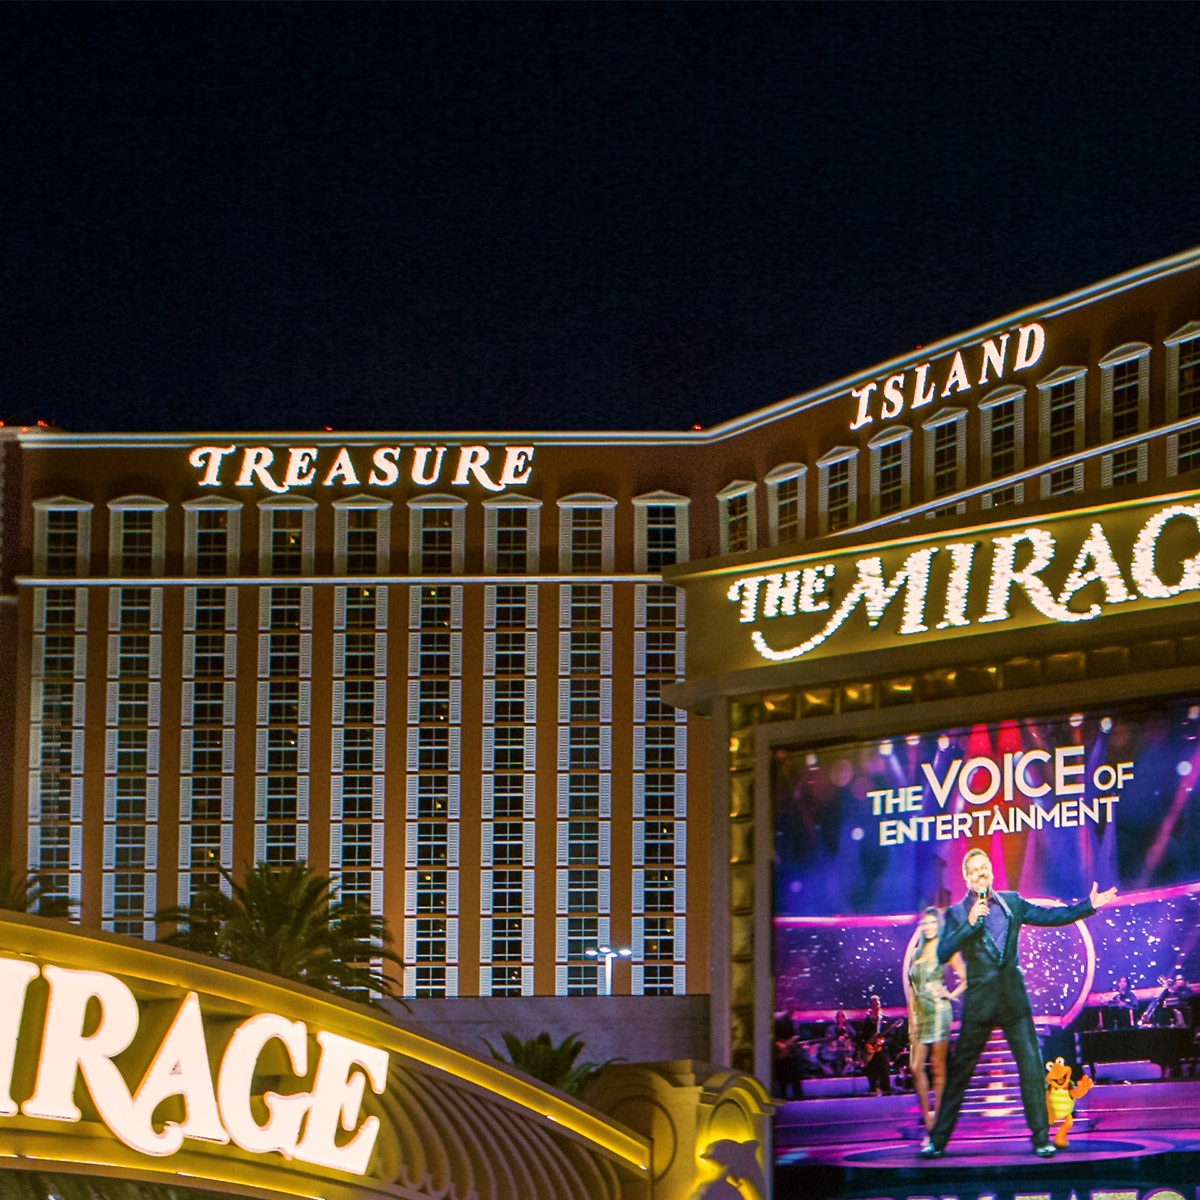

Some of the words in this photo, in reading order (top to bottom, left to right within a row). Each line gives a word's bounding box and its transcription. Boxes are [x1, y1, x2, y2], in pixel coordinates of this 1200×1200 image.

[850, 323, 1047, 430] ISLAND
[189, 444, 535, 493] TREASURE
[727, 563, 836, 625] THE
[866, 785, 923, 816] THE
[922, 745, 1085, 808] VOICE
[1093, 761, 1134, 791] OF
[879, 795, 1119, 847] ENTERTAINMENT
